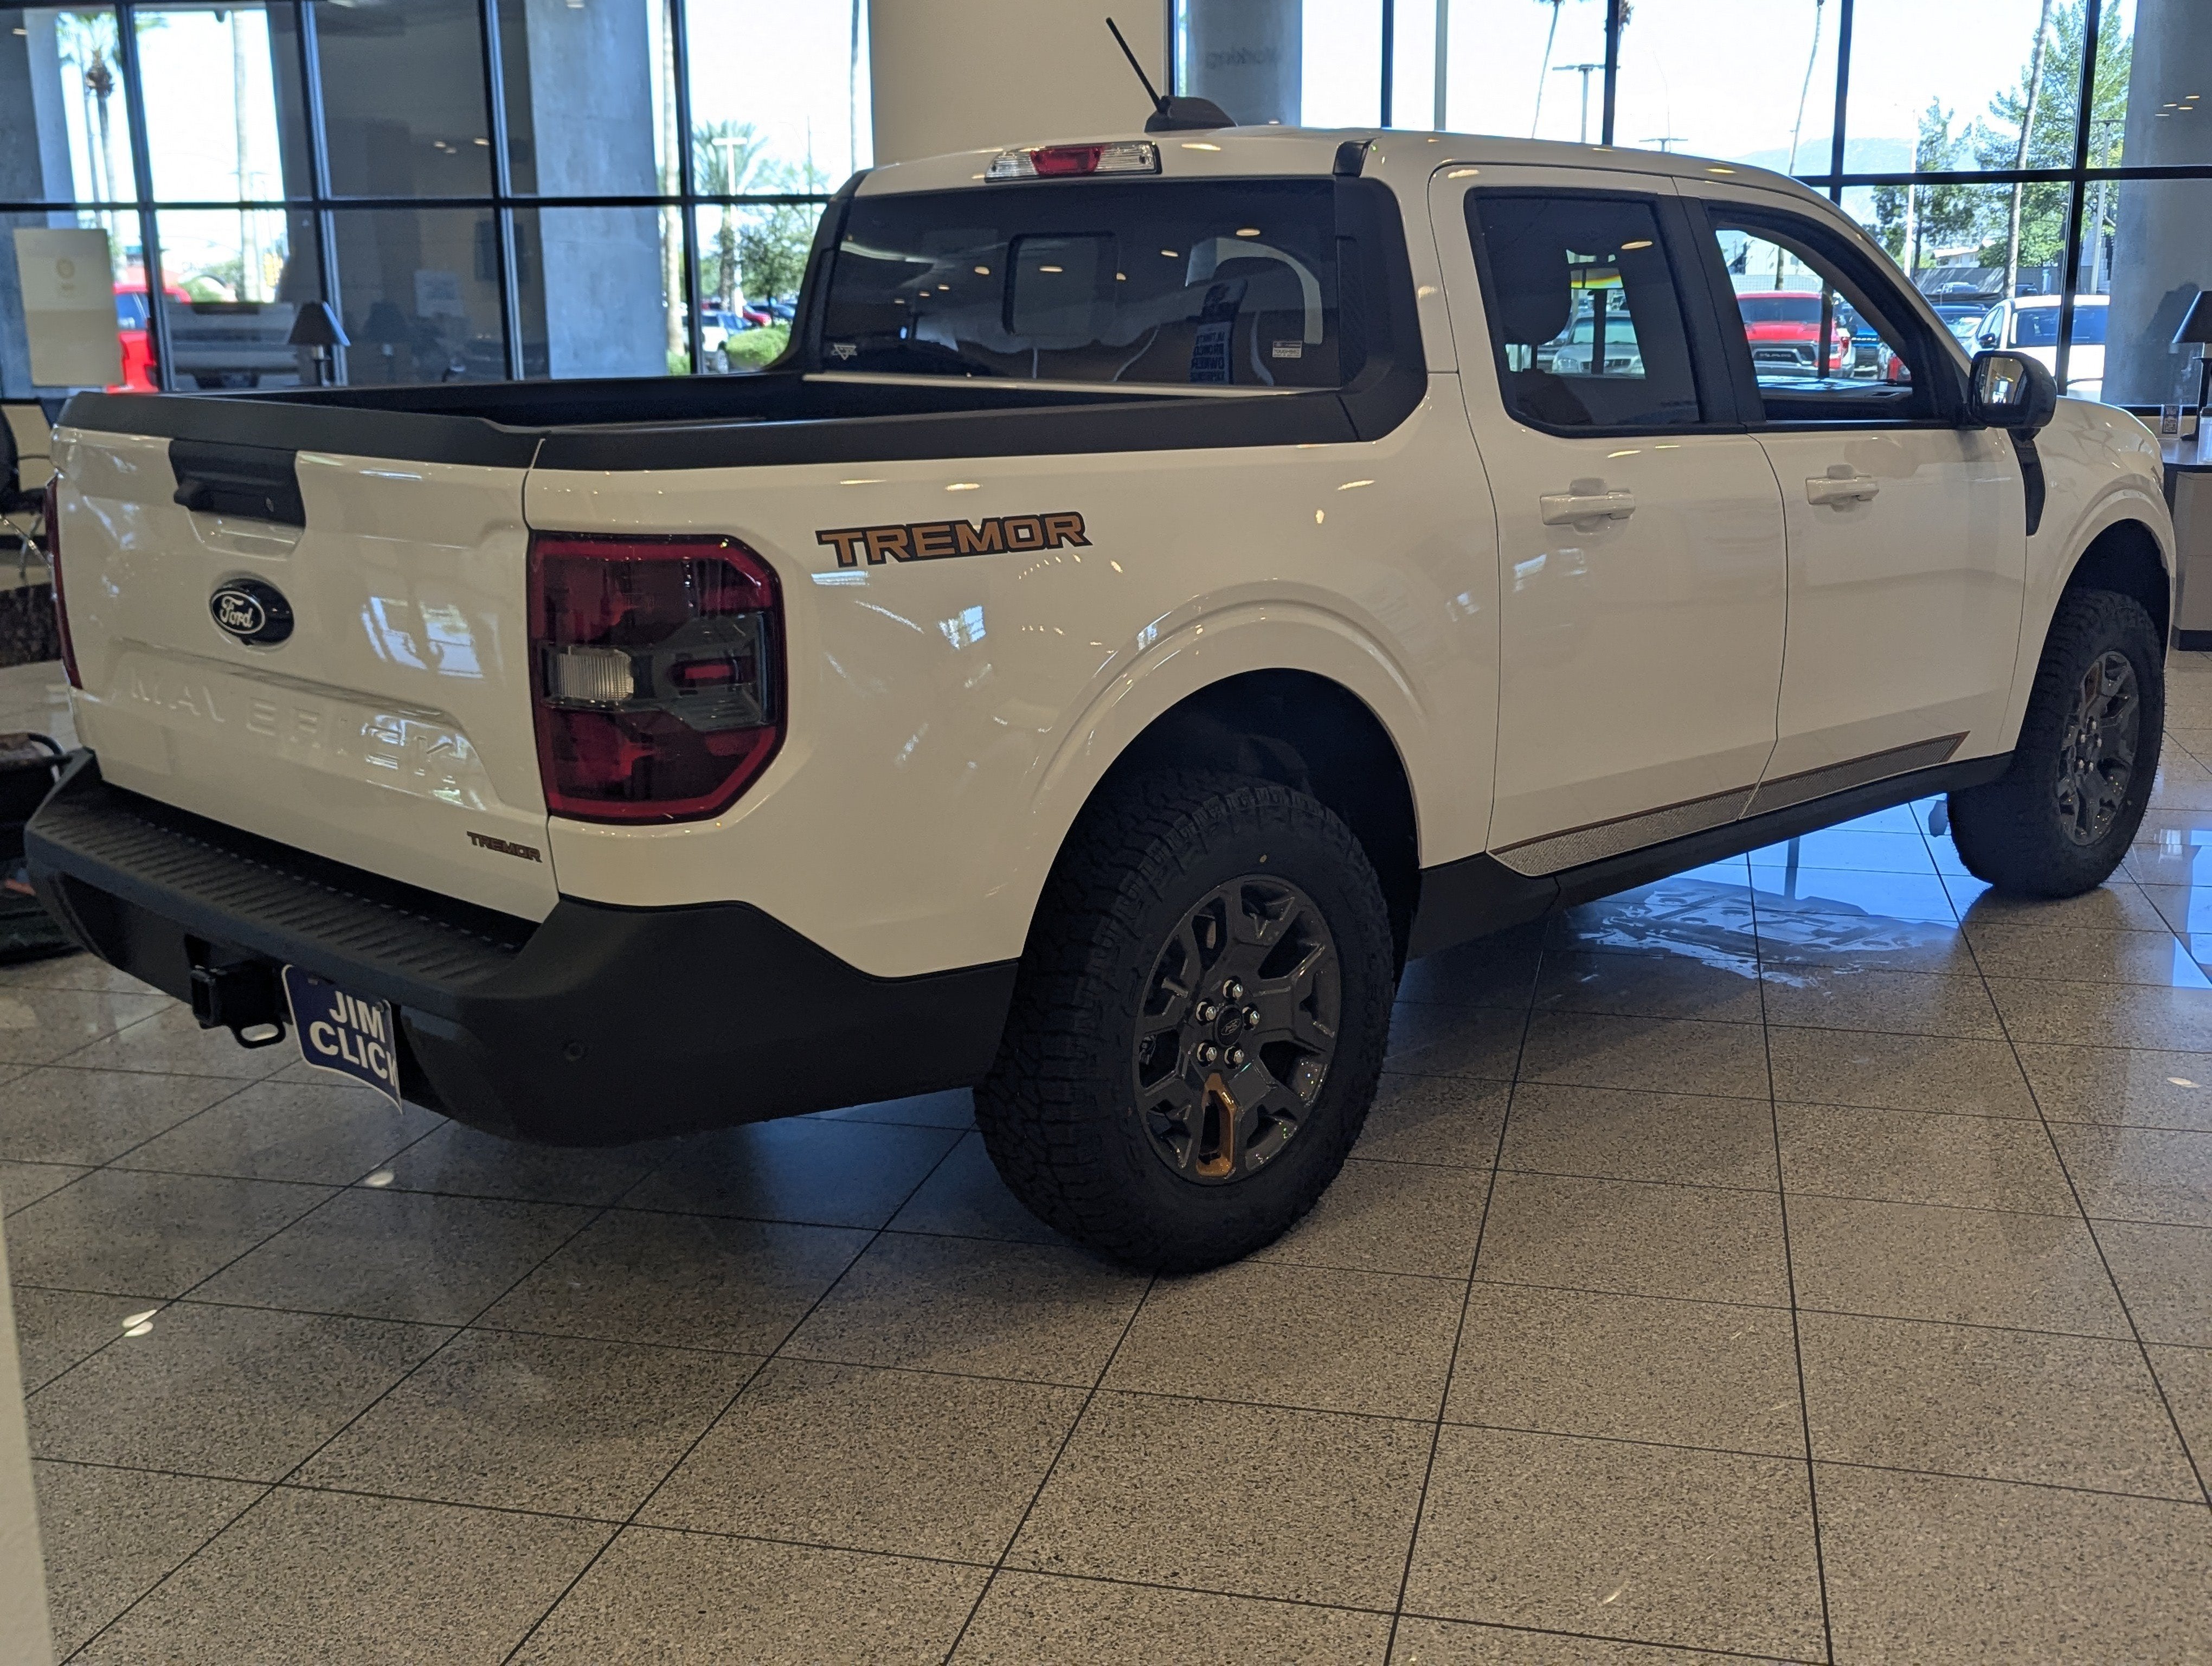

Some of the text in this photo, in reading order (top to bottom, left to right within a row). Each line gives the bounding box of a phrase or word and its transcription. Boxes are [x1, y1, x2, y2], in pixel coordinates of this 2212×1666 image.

[815, 511, 1093, 568] TREMOR
[220, 595, 253, 628] Ford
[466, 831, 543, 863] TREMOR
[329, 990, 385, 1043] JIM
